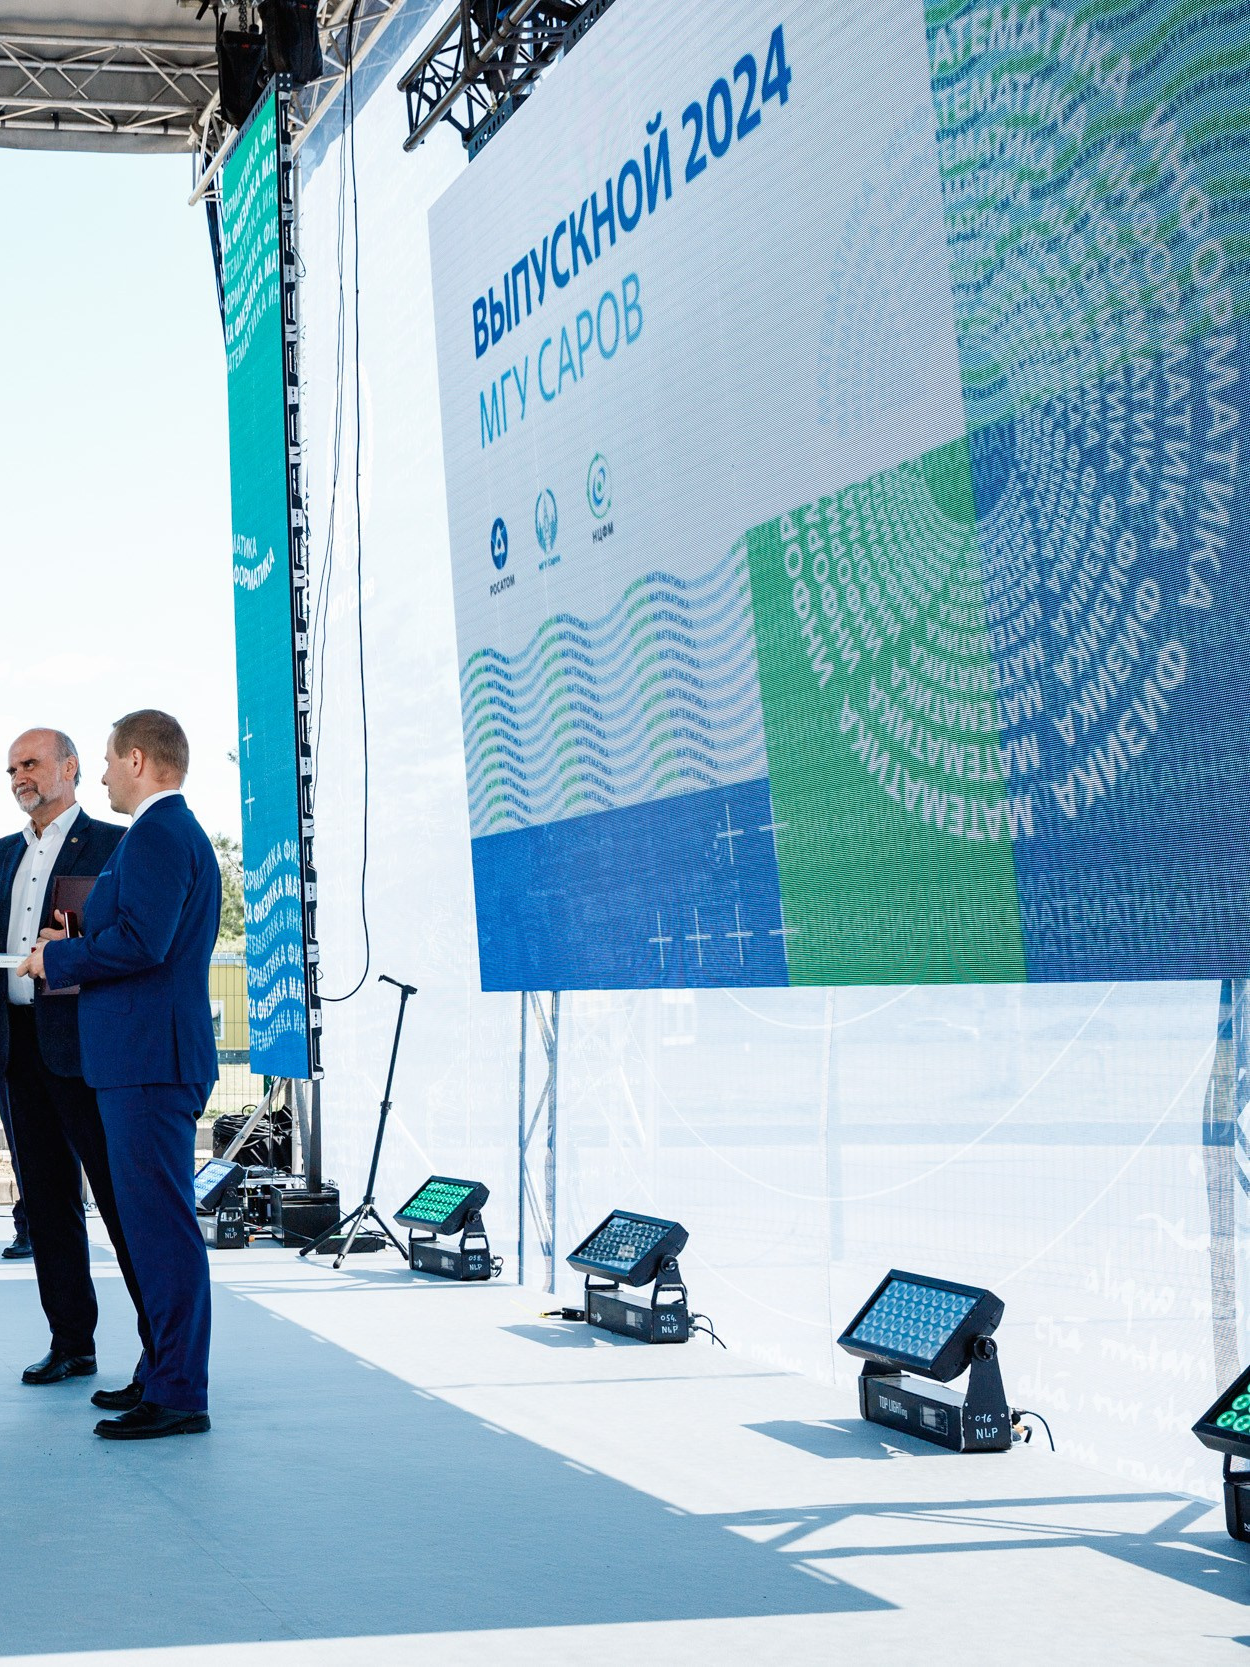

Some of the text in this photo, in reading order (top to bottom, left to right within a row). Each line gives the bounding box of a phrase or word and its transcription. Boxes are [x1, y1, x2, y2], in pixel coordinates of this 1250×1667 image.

[472, 111, 673, 359] ВЫПУСКНОЙ
[681, 23, 793, 184] 2024
[479, 272, 644, 448] МГУ САРОВ
[592, 522, 614, 543] НЦФМ
[1051, 495, 1117, 637] ФИЗИКА
[234, 564, 275, 591] ФОРМАТИКА
[490, 574, 515, 597] РОСАТОМ
[1054, 531, 1138, 687] ФИЗИКА
[891, 656, 1044, 732] МАТЕМАТИКА
[1053, 577, 1161, 746] ФИЗИКА
[868, 676, 1040, 781] МАТЕМАТИКА
[1053, 640, 1188, 818] ФИЗИКА
[840, 694, 1034, 841] МАТЕМАТИКА
[254, 875, 284, 924] ФИЗИКА
[258, 977, 287, 1021] ФИЗИКА
[661, 1325, 679, 1334] NLP
[879, 1395, 888, 1409] TOP
[976, 1427, 999, 1440] NLP
